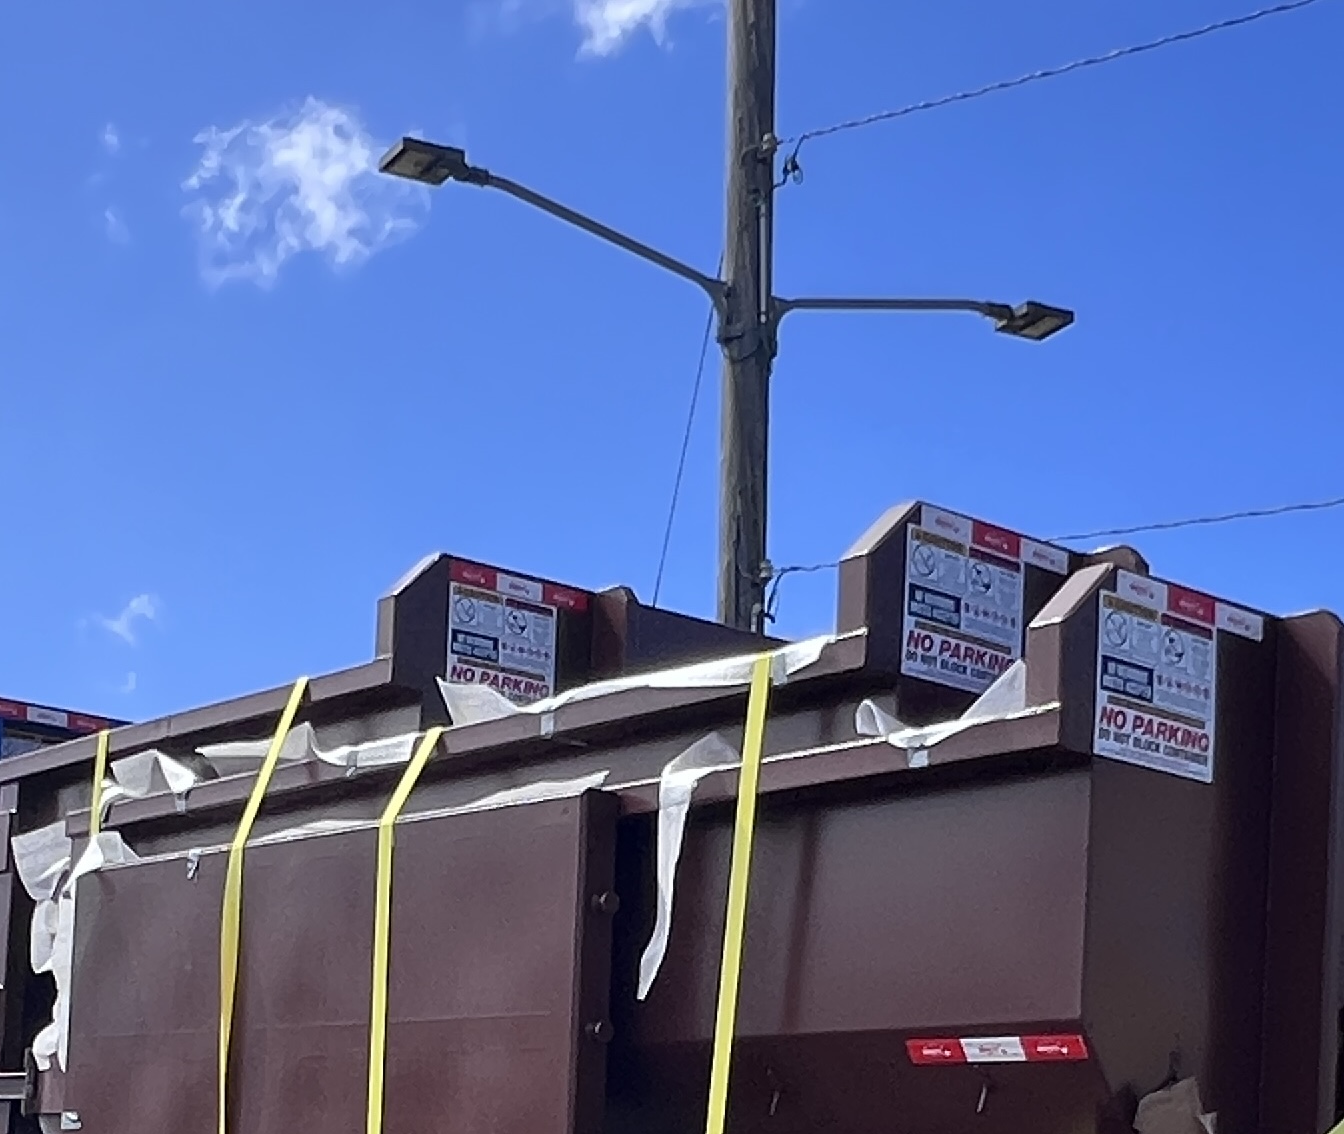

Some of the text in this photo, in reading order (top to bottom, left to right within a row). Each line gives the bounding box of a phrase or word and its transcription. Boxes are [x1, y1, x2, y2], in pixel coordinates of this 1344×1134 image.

[906, 630, 934, 652] NO
[451, 665, 476, 682] NO
[1099, 706, 1127, 730] NO
[1133, 714, 1210, 751] PARKING
